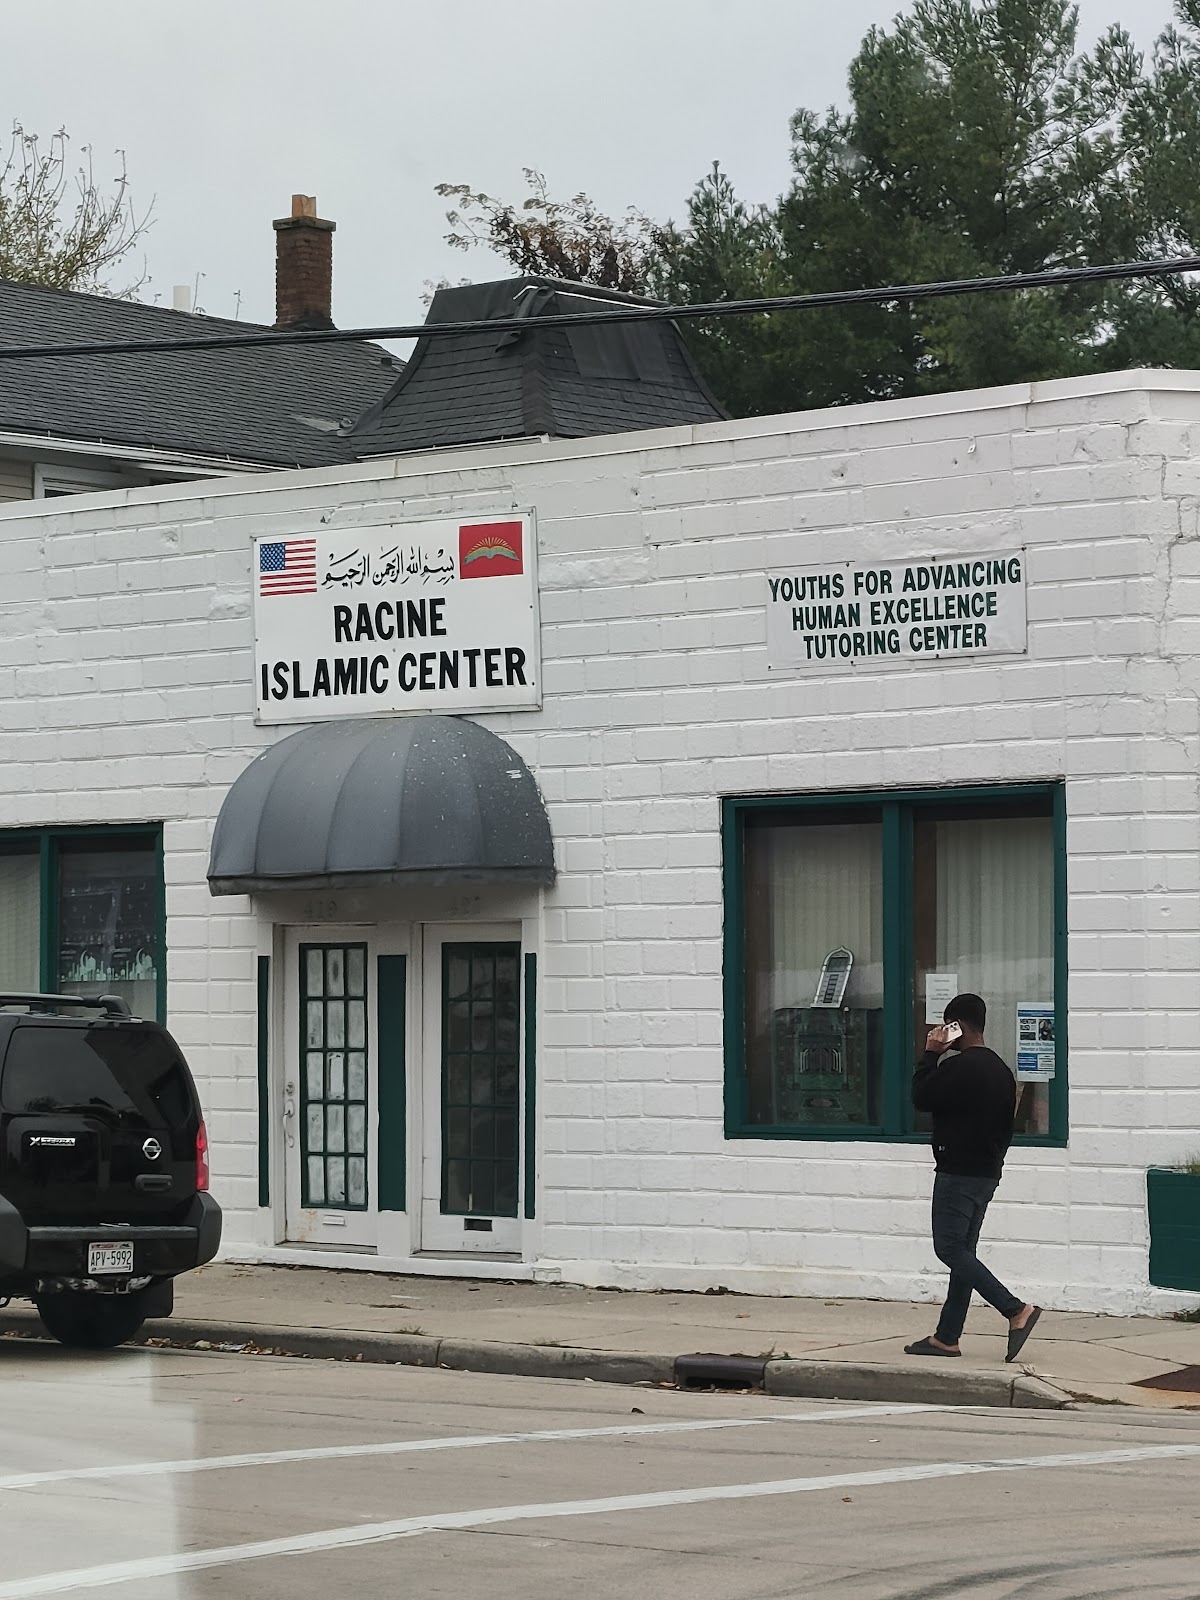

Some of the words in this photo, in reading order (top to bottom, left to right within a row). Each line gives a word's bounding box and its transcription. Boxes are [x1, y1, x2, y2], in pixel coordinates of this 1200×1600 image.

[768, 573, 844, 602] YOUTHS
[854, 569, 893, 595] FOR
[902, 558, 1022, 592] ADVANCING
[333, 597, 447, 643] RACINE
[792, 602, 861, 631] HUMAN
[870, 591, 998, 626] EXCELLENCE
[803, 628, 900, 659] TUTORING
[909, 623, 987, 652] CENTER
[261, 655, 389, 701] ISLAMIC
[398, 647, 527, 692] CENTER
[90, 1250, 132, 1267] APV-5992
